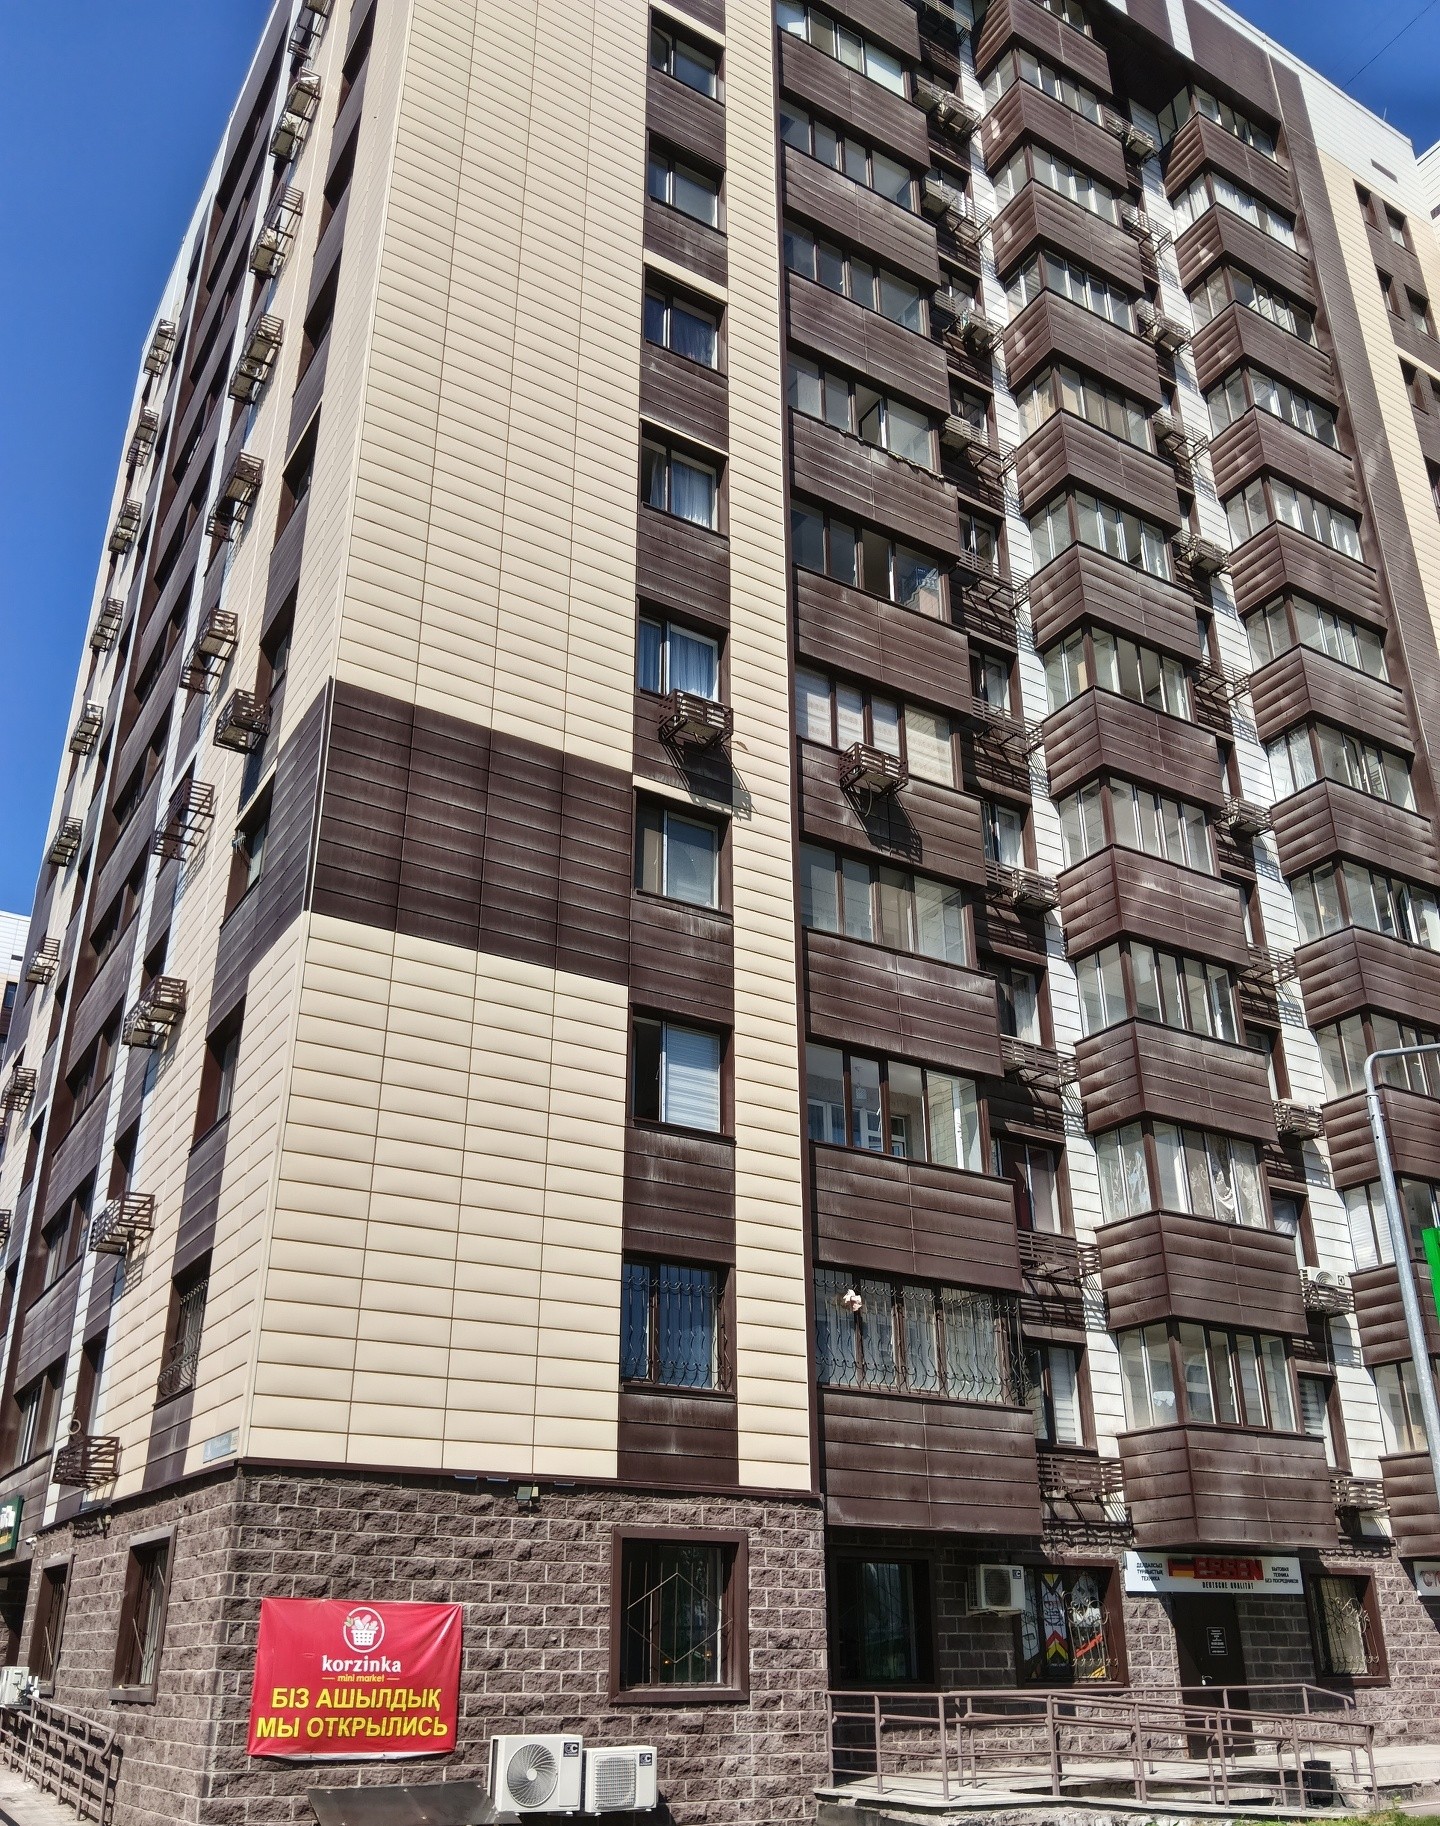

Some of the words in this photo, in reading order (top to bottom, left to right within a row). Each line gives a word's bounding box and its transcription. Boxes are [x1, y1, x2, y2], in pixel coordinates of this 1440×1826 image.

[1202, 1581, 1229, 1589] DEUTSCHE
[321, 1654, 402, 1673] korzinka
[337, 1674, 356, 1683] mini
[356, 1674, 386, 1683] market
[271, 1687, 310, 1709] БІЗ
[316, 1688, 442, 1712] АШЫЛДЫҚ
[256, 1717, 301, 1738] МЫ
[307, 1716, 449, 1738] ОТКРЫЛИСЬ
